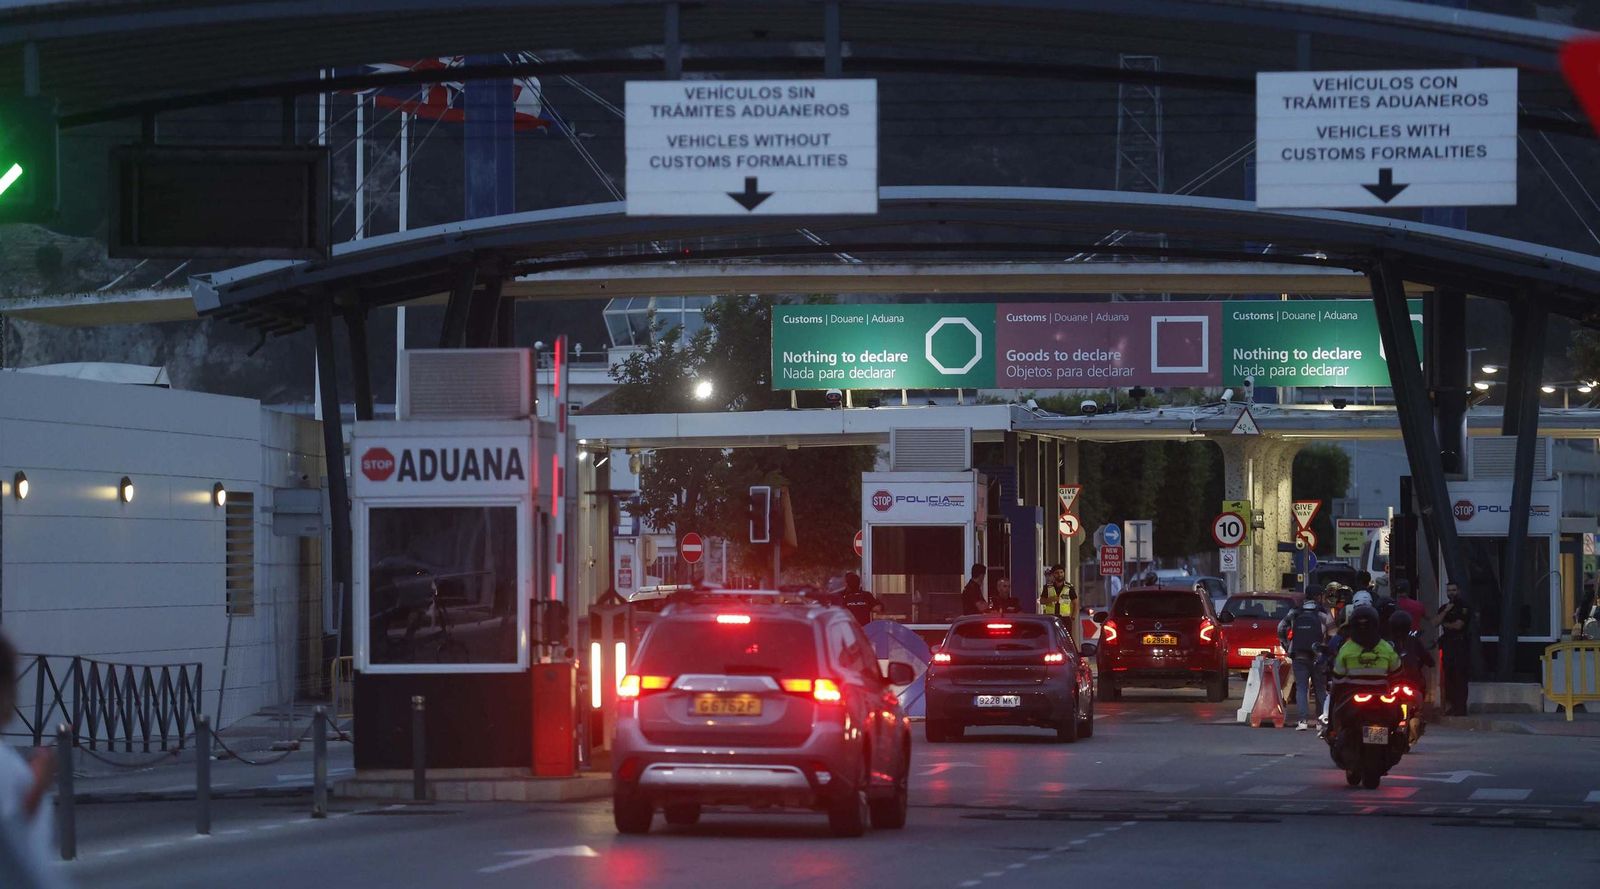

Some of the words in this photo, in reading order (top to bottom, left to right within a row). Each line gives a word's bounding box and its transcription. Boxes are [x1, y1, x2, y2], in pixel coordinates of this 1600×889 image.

[1312, 75, 1414, 91] VEHÍCULOS
[1420, 76, 1458, 89] CON
[684, 84, 782, 100] VEHÍCULOS
[788, 87, 815, 99] SIN
[1283, 94, 1370, 109] TRÁMITES
[1376, 94, 1488, 108] ADUANEROS
[650, 102, 736, 118] TRÁMITES
[742, 104, 850, 117] ADUANEROS
[1317, 125, 1402, 139] VEHICLES
[1407, 124, 1450, 138] WITH
[667, 134, 749, 148] VEHICLES
[754, 133, 831, 147] WITHOUT
[1281, 147, 1366, 161] CUSTOMS
[1371, 145, 1488, 159] FORMALITIES
[650, 155, 731, 169] CUSTOMS
[737, 154, 848, 168] FORMALITIES
[783, 314, 823, 324] Customs
[830, 314, 864, 324] Douane
[871, 313, 905, 324] Aduana
[1006, 313, 1047, 323] Customs
[1054, 312, 1089, 323] Douane
[1095, 312, 1130, 322] Aduana
[1233, 310, 1275, 321] Customs
[1281, 311, 1316, 321] Douane
[1323, 311, 1358, 321] Aduana
[783, 351, 837, 366] Nothing
[842, 351, 856, 363] to
[860, 350, 908, 363] declare
[1006, 349, 1050, 362] Goods
[1055, 350, 1069, 362] to
[1073, 348, 1122, 361] declare
[1233, 347, 1289, 362] Nothing
[1293, 348, 1308, 360] to
[1312, 347, 1362, 360] declare
[783, 366, 814, 380] Nada
[818, 369, 845, 383] para
[848, 366, 896, 379] declarar
[1006, 365, 1053, 381] Objetos
[1056, 367, 1084, 381] para
[1087, 364, 1135, 378] declarar
[1233, 364, 1265, 376] Nada
[1269, 366, 1297, 380] para
[1300, 362, 1350, 376] declarar
[363, 459, 393, 470] STOP
[397, 448, 525, 482] ADUANA
[873, 496, 892, 506] STOP
[1294, 503, 1313, 511] GIVE
[1454, 505, 1474, 516] STOP
[1477, 505, 1534, 513] POLIA
[1219, 521, 1240, 537] 10
[1002, 697, 1019, 705] MKY
